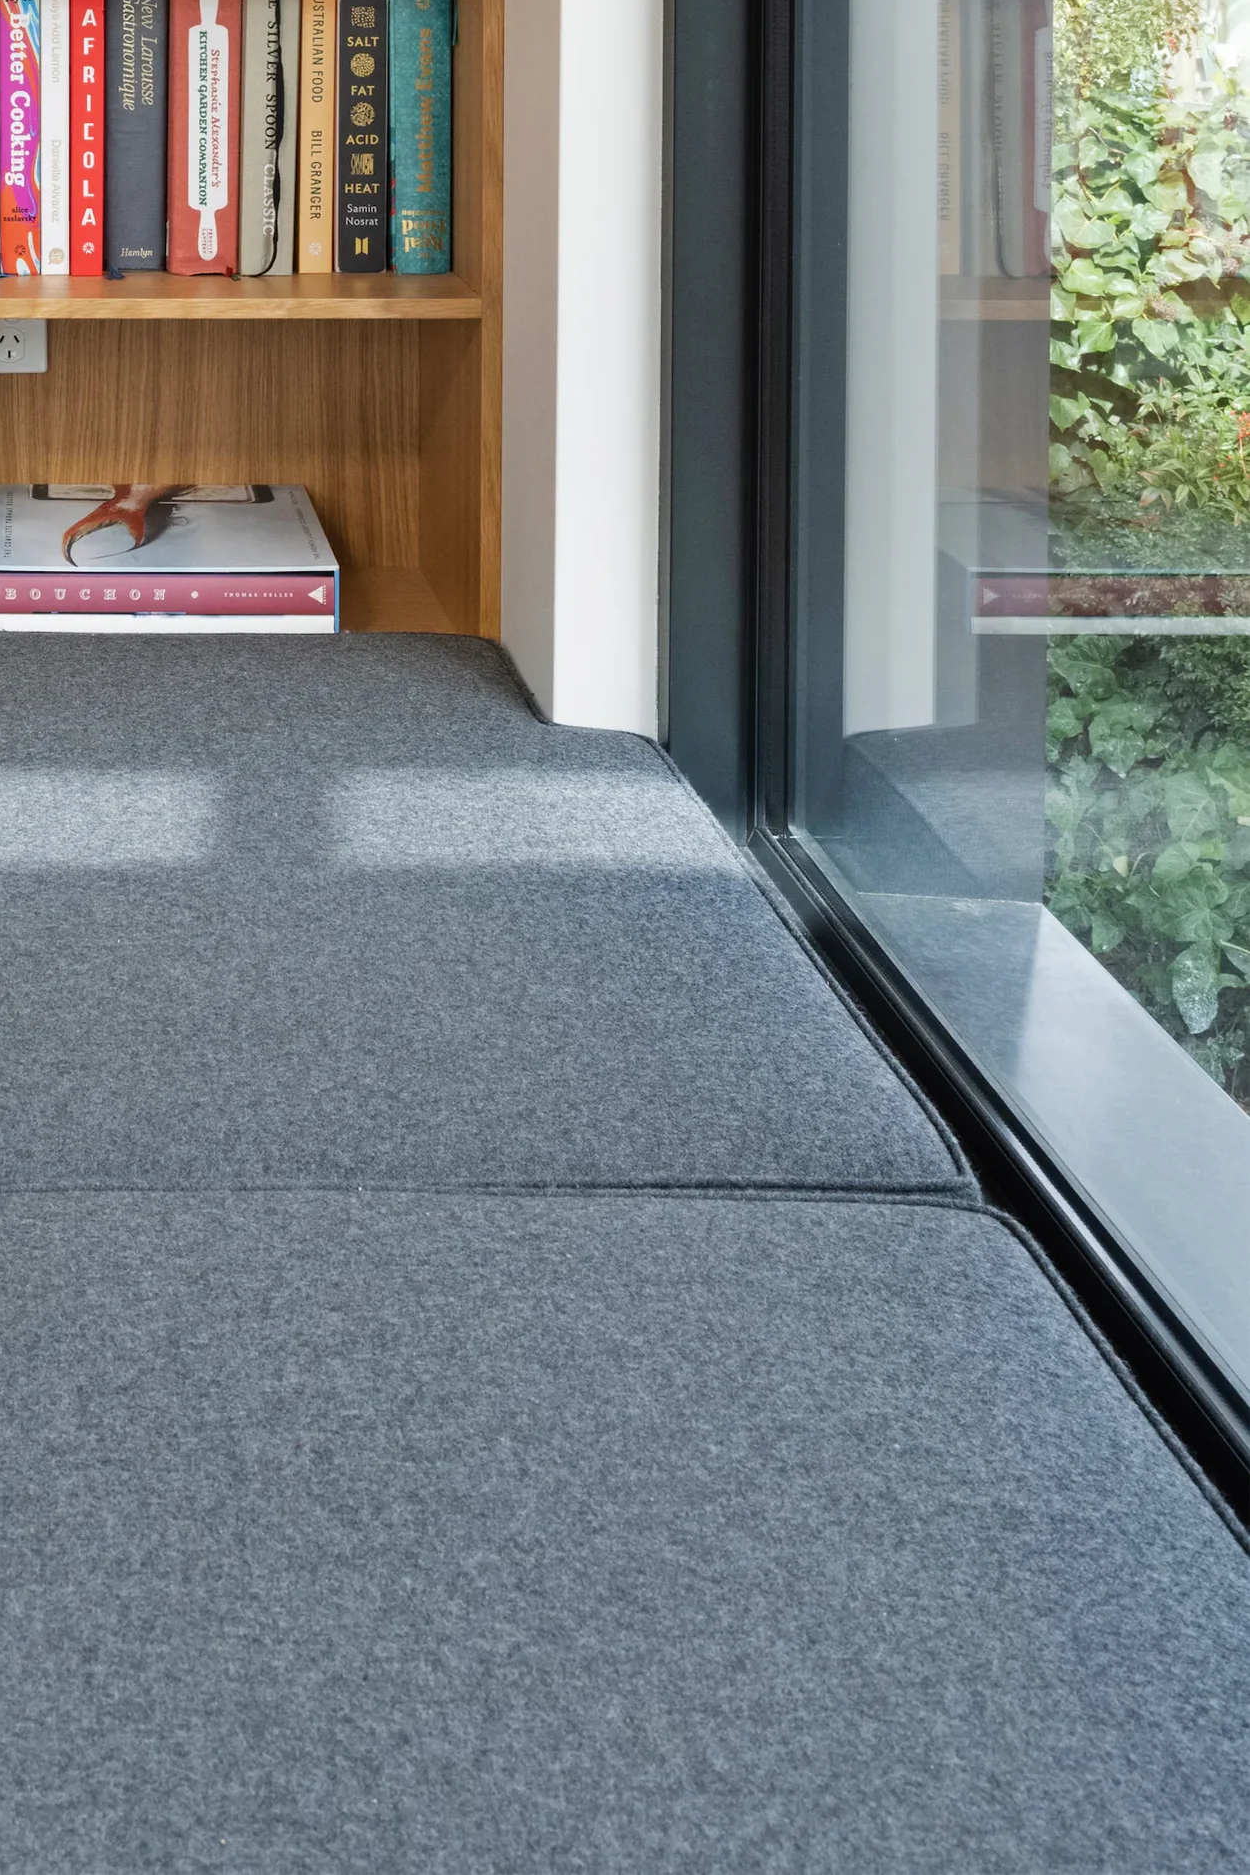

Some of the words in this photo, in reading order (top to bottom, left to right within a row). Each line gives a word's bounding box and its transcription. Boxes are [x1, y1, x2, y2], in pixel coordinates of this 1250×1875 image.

[10, 13, 29, 84] Better
[347, 37, 379, 47] SALT
[141, 36, 158, 105] Larousse
[416, 29, 434, 90] Evans
[311, 71, 323, 103] FOOD
[351, 86, 375, 96] FAT
[5, 91, 30, 187] Cooking
[311, 130, 322, 156] BILL
[346, 135, 379, 145] ACID
[416, 93, 434, 193] Matthew
[263, 163, 276, 236] CLASSIC
[310, 161, 322, 219] GRANGER
[345, 184, 380, 194] HEAT
[346, 216, 378, 226] Nosrat
[347, 204, 377, 214] Samin
[120, 248, 153, 257] Hamlyn
[5, 588, 166, 601] BOUCHON
